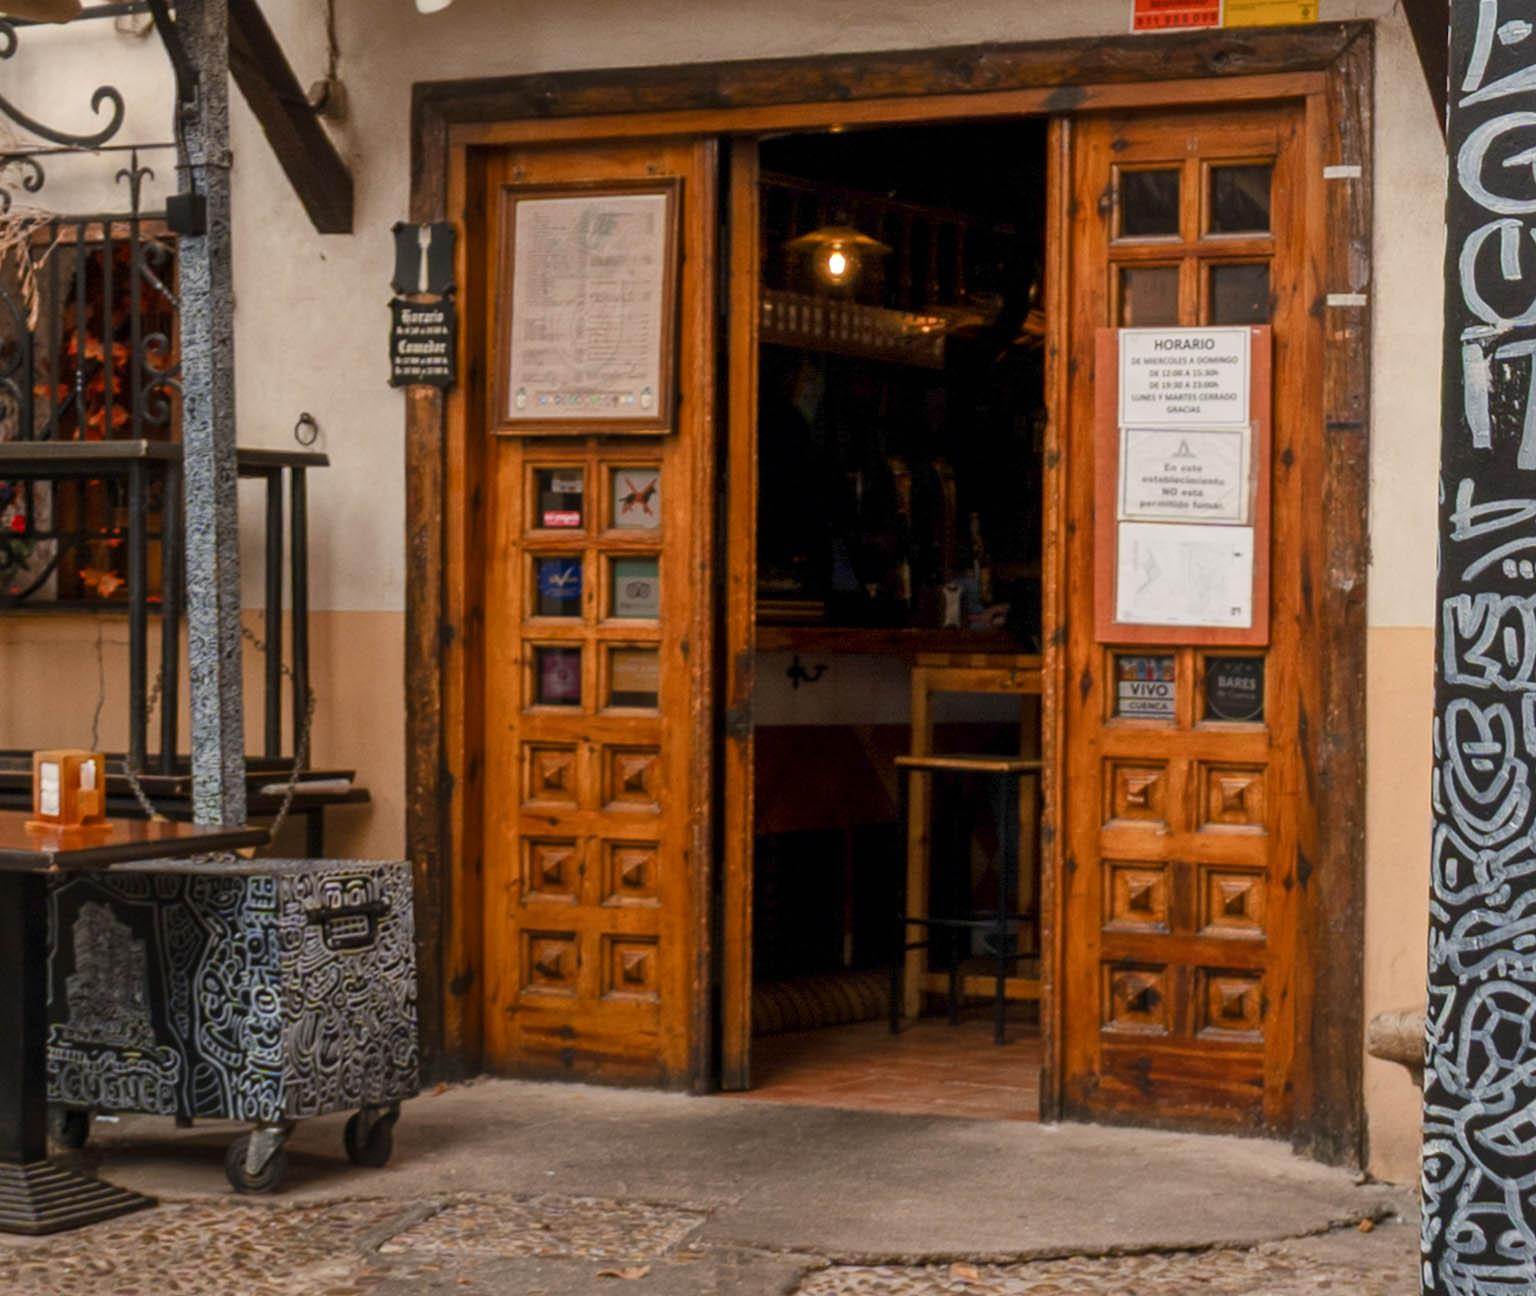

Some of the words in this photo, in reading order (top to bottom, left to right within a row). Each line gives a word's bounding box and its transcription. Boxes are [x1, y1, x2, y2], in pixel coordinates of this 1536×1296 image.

[1153, 338, 1216, 351] HORARIO
[1164, 392, 1197, 402] MARTES
[1166, 405, 1201, 414] GRACIAS
[1161, 487, 1178, 497] NO
[1217, 675, 1257, 691] BARES
